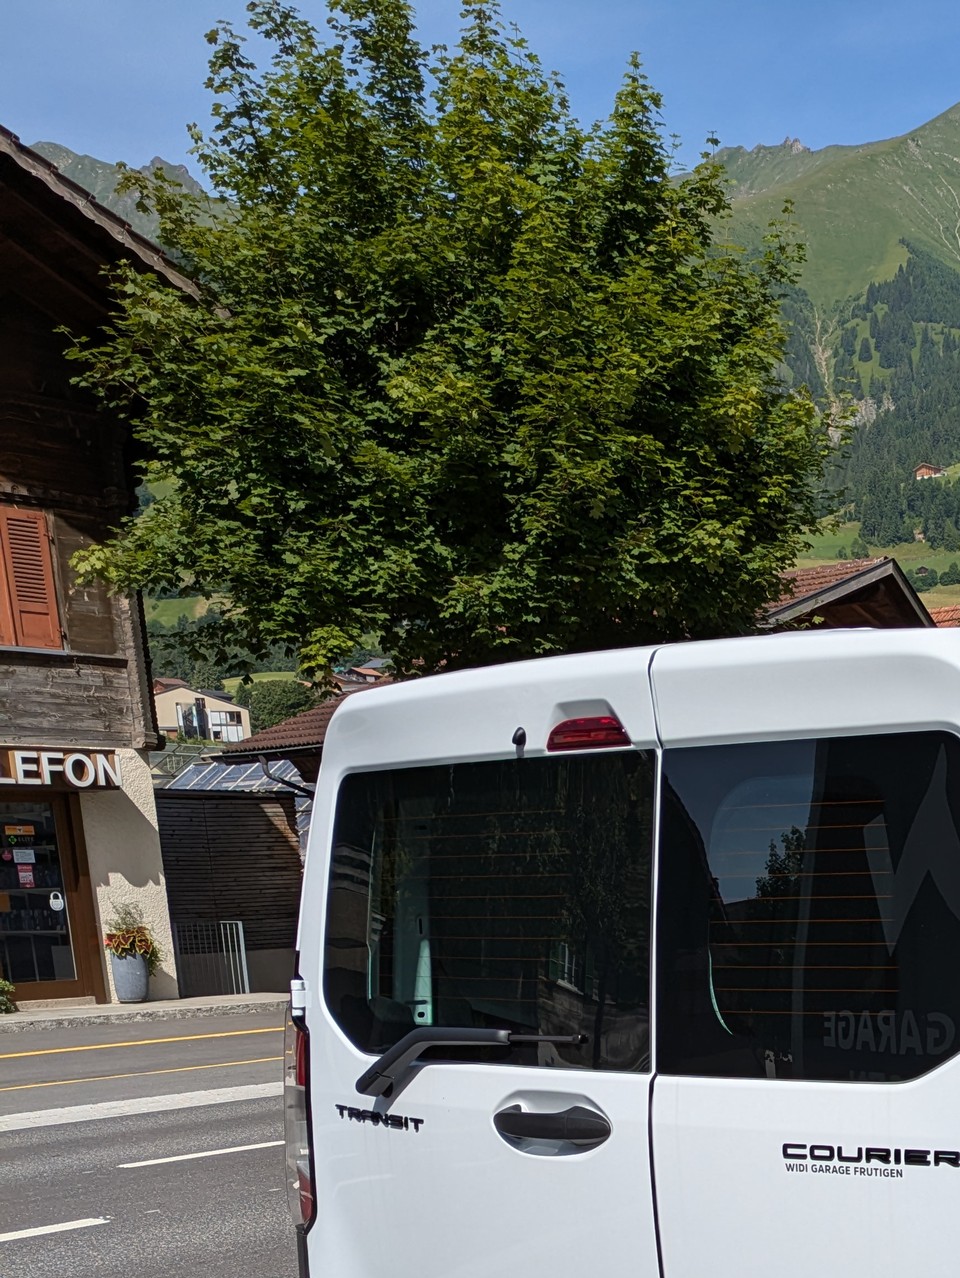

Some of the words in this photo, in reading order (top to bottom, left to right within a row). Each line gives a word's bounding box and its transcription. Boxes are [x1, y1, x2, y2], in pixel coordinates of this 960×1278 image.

[335, 1104, 424, 1133] TRANSIT
[782, 1143, 960, 1168] COURIER
[785, 1163, 808, 1173] WIDI
[811, 1164, 851, 1175] GARAGE
[854, 1167, 903, 1178] FRUTIGEN
